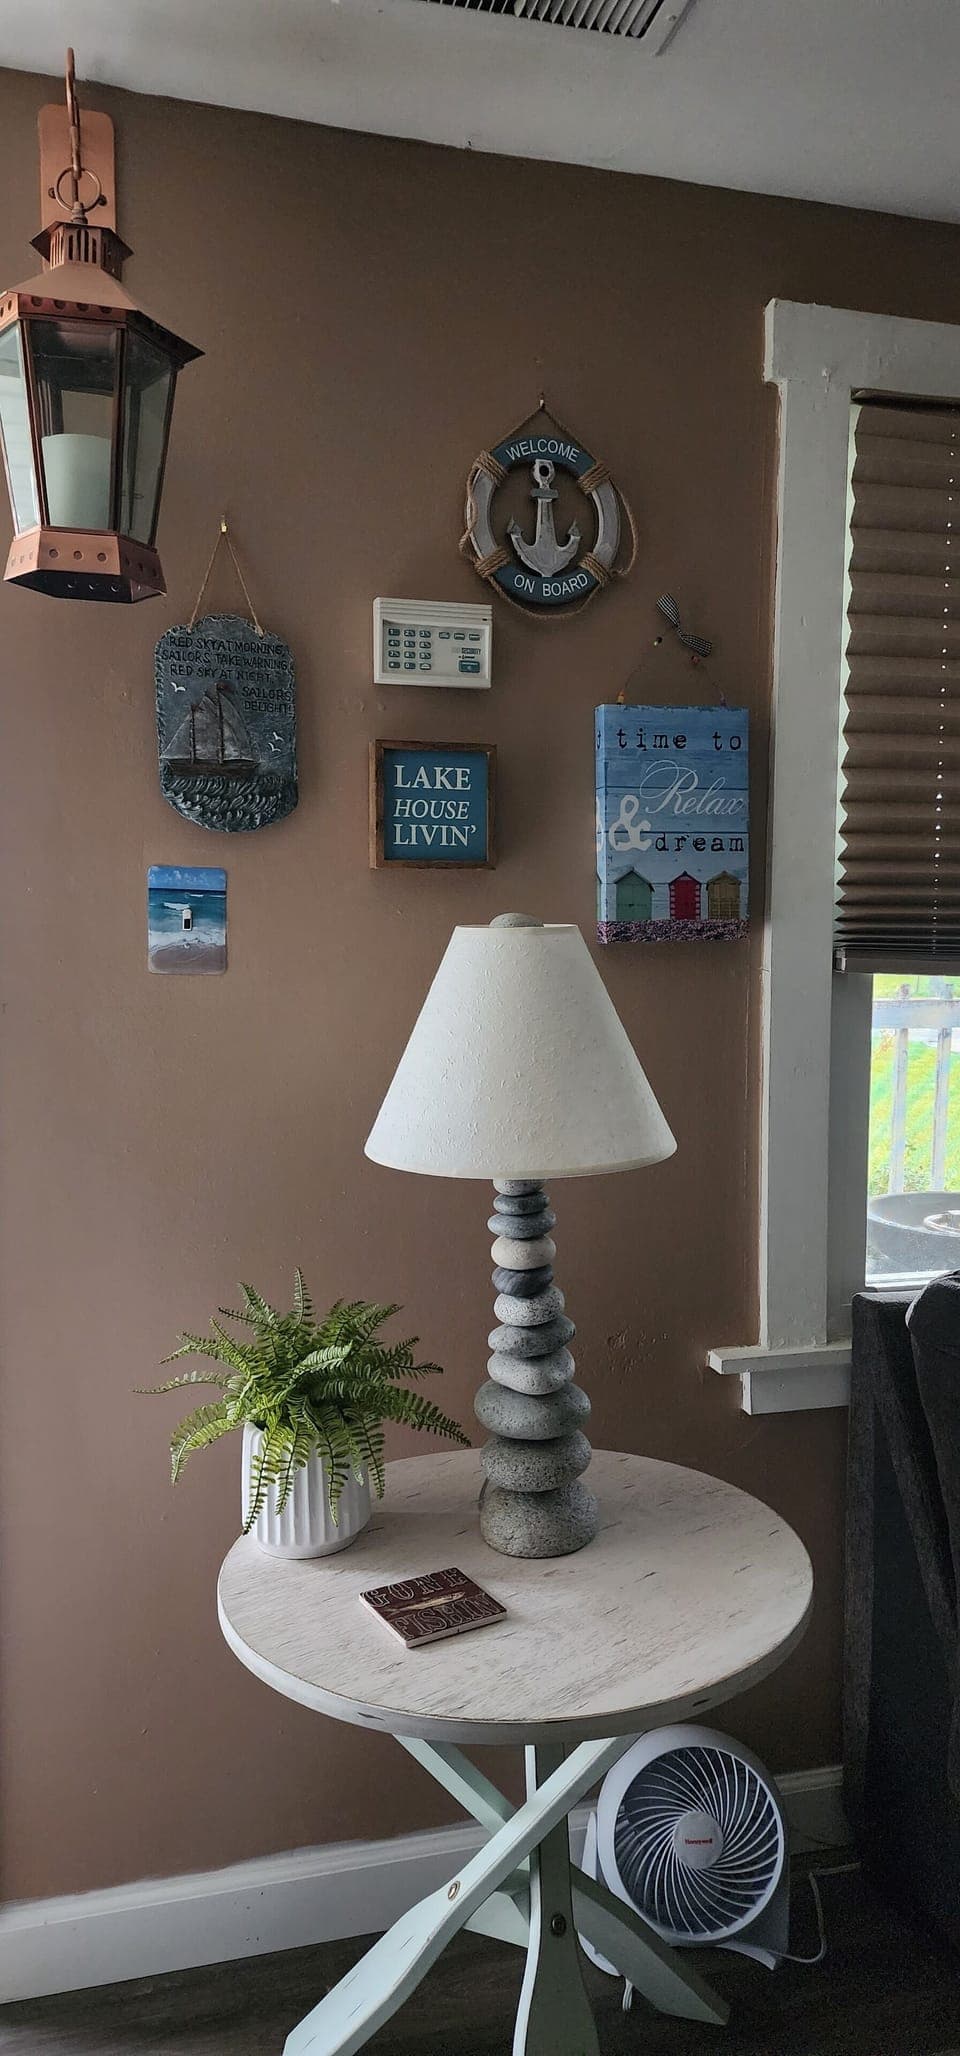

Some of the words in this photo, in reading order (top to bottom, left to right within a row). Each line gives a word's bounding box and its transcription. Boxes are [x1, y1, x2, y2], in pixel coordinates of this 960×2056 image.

[506, 438, 580, 463] WELCOME
[514, 574, 535, 593] ON
[542, 573, 588, 597] BOARD
[169, 636, 193, 648] RED
[196, 639, 218, 651] SKY
[217, 640, 234, 652] AT
[161, 649, 211, 664] SAILORS
[215, 653, 242, 666] TAKE
[170, 664, 194, 677] RED
[196, 666, 218, 679] SKY
[219, 668, 235, 681] AT
[242, 686, 292, 702] SAILORS
[616, 727, 687, 750] time
[712, 731, 742, 751] to
[394, 765, 471, 790] LAKE
[640, 760, 744, 815] Relax
[393, 799, 470, 819] HOUSE
[609, 795, 652, 851] &
[655, 833, 744, 852] dream
[363, 1568, 467, 1608] GONE
